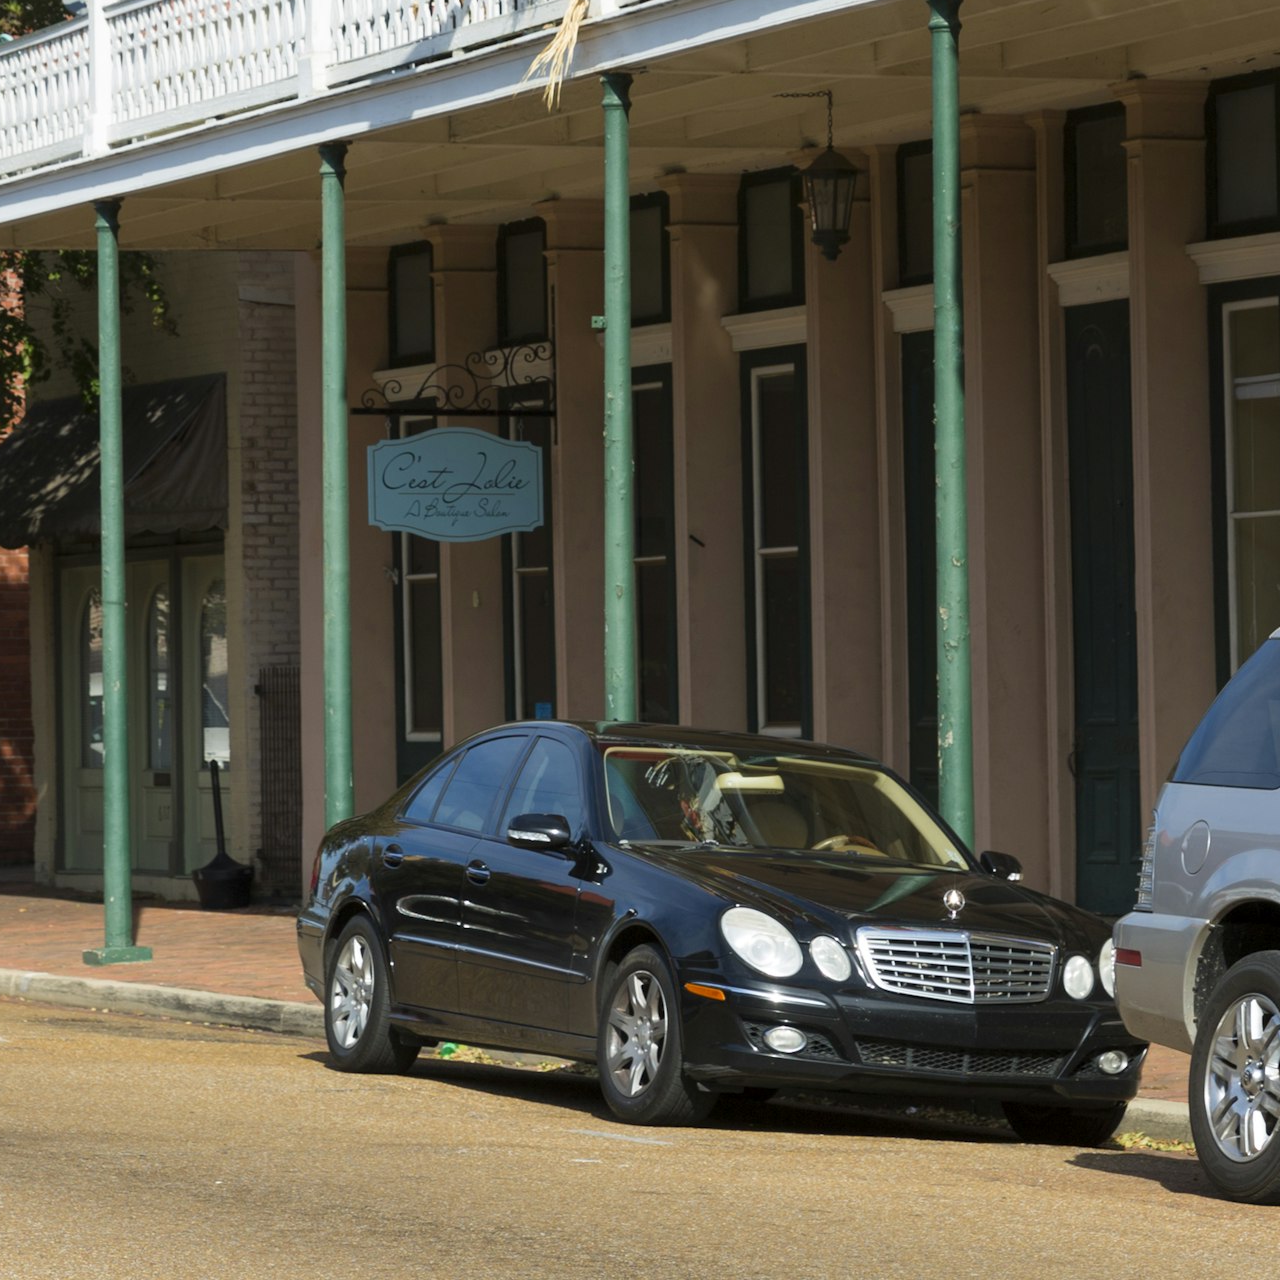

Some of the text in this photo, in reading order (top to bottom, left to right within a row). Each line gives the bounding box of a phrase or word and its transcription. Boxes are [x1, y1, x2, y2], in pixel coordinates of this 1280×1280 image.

[382, 451, 530, 504] C'est Jolie
[423, 497, 470, 527] Boutique
